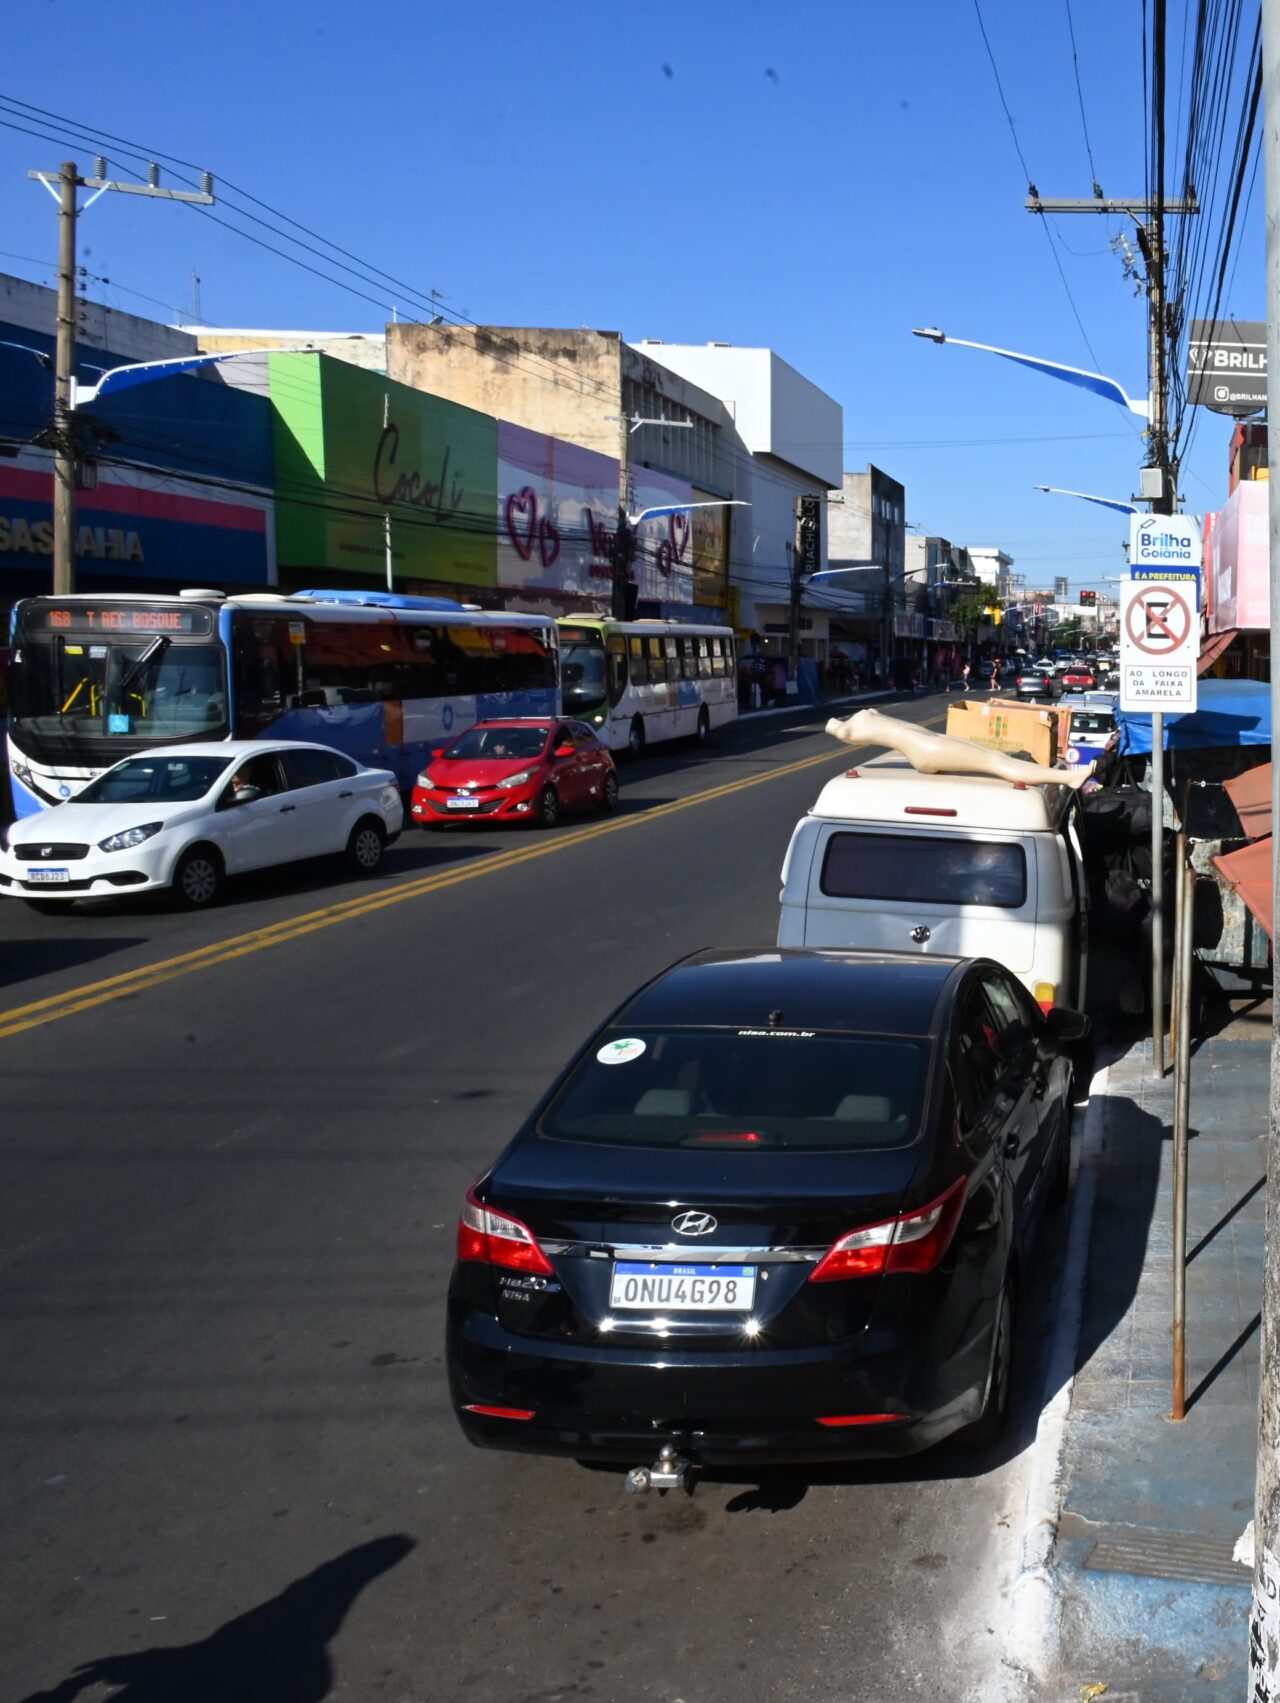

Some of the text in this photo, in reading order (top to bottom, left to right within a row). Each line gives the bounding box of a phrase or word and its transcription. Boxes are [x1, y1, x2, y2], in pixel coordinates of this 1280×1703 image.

[1141, 533, 1191, 547] Brilha
[1141, 548, 1191, 559] Goiânia
[1149, 573, 1196, 581] PREFEITURA
[1152, 670, 1188, 678] LONGO
[1135, 689, 1182, 697] AMARELA
[737, 1029, 816, 1038] nisa.com.br
[672, 1267, 697, 1275] BRASIL
[624, 1277, 738, 1304] ONU4G98
